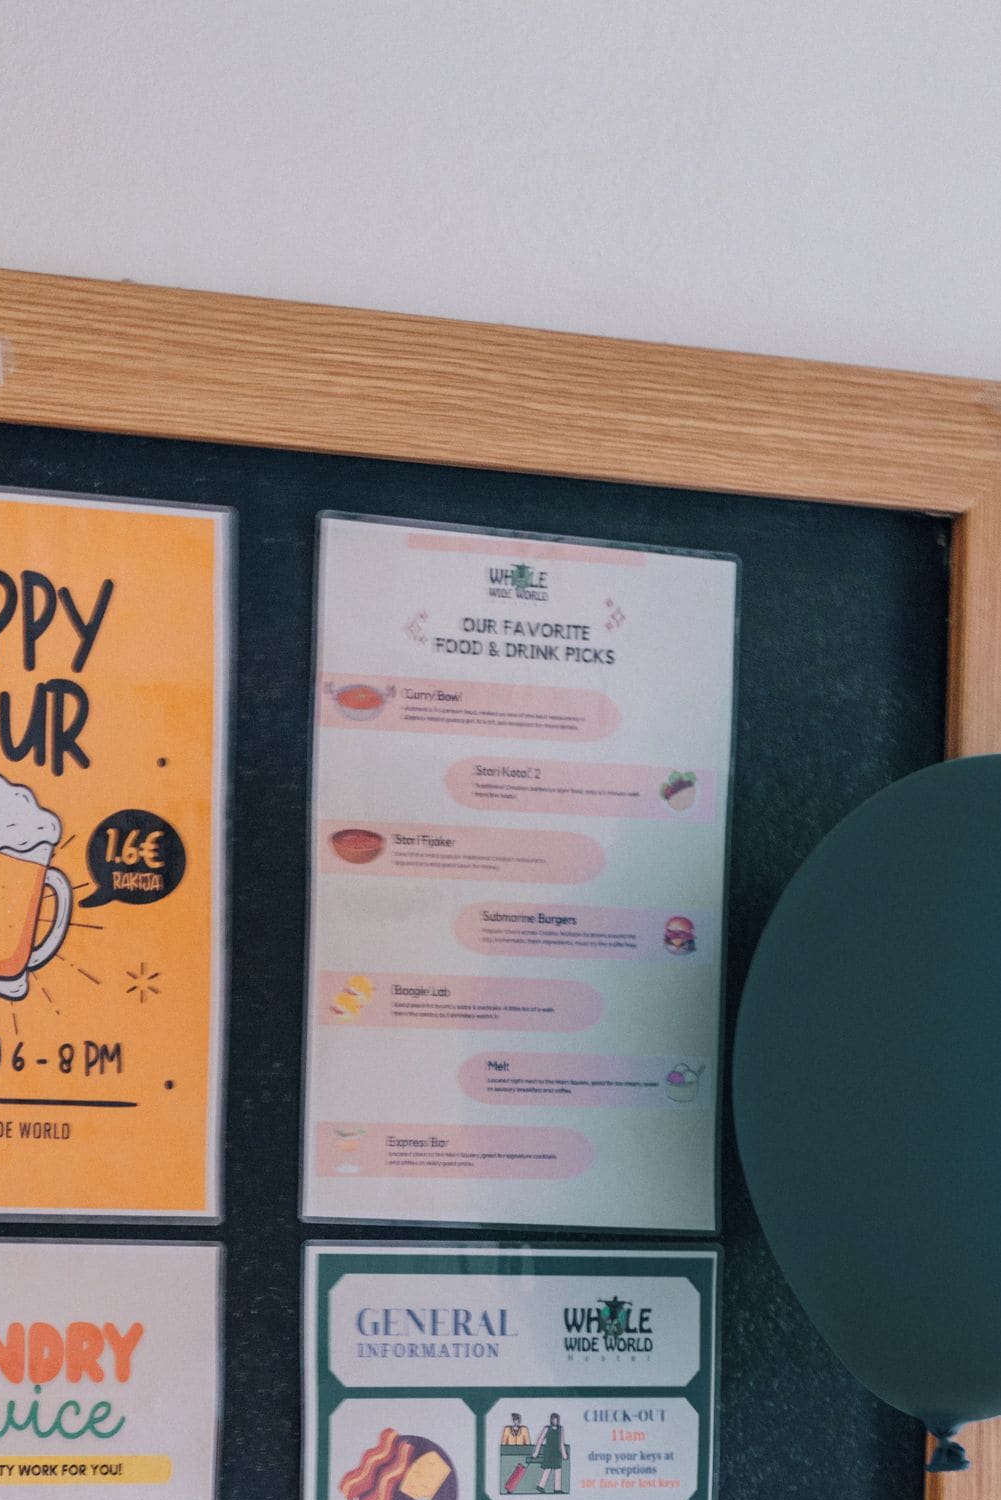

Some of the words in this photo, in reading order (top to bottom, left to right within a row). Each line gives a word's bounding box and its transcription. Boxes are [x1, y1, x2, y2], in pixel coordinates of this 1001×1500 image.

[463, 616, 497, 635] OUR
[504, 620, 590, 641] FAVORITE
[436, 637, 483, 656] FOOD
[489, 642, 500, 656] &
[505, 643, 559, 661] DRINK
[565, 647, 615, 664] PICKS
[105, 828, 165, 868] 1.6€
[538, 913, 577, 926] Burgers
[12, 1041, 24, 1071] 6
[58, 1043, 72, 1073] 8
[84, 1041, 122, 1076] PM
[488, 1061, 509, 1072] Melt
[19, 1121, 71, 1140] WORLD
[356, 1307, 519, 1337] GENERAL
[357, 1342, 500, 1359] INFORMATION
[564, 1337, 598, 1352] WIDE
[603, 1337, 653, 1353] WORLD
[584, 1409, 666, 1422] CHECK-OUT
[612, 1429, 645, 1441] 11am
[588, 1451, 612, 1463] drop
[615, 1453, 637, 1463] your
[640, 1451, 662, 1463] keys
[664, 1452, 674, 1460] at
[18, 1464, 57, 1477] WORK
[62, 1464, 86, 1476] FOR
[90, 1463, 122, 1476] YOU!
[605, 1465, 657, 1477] receptions
